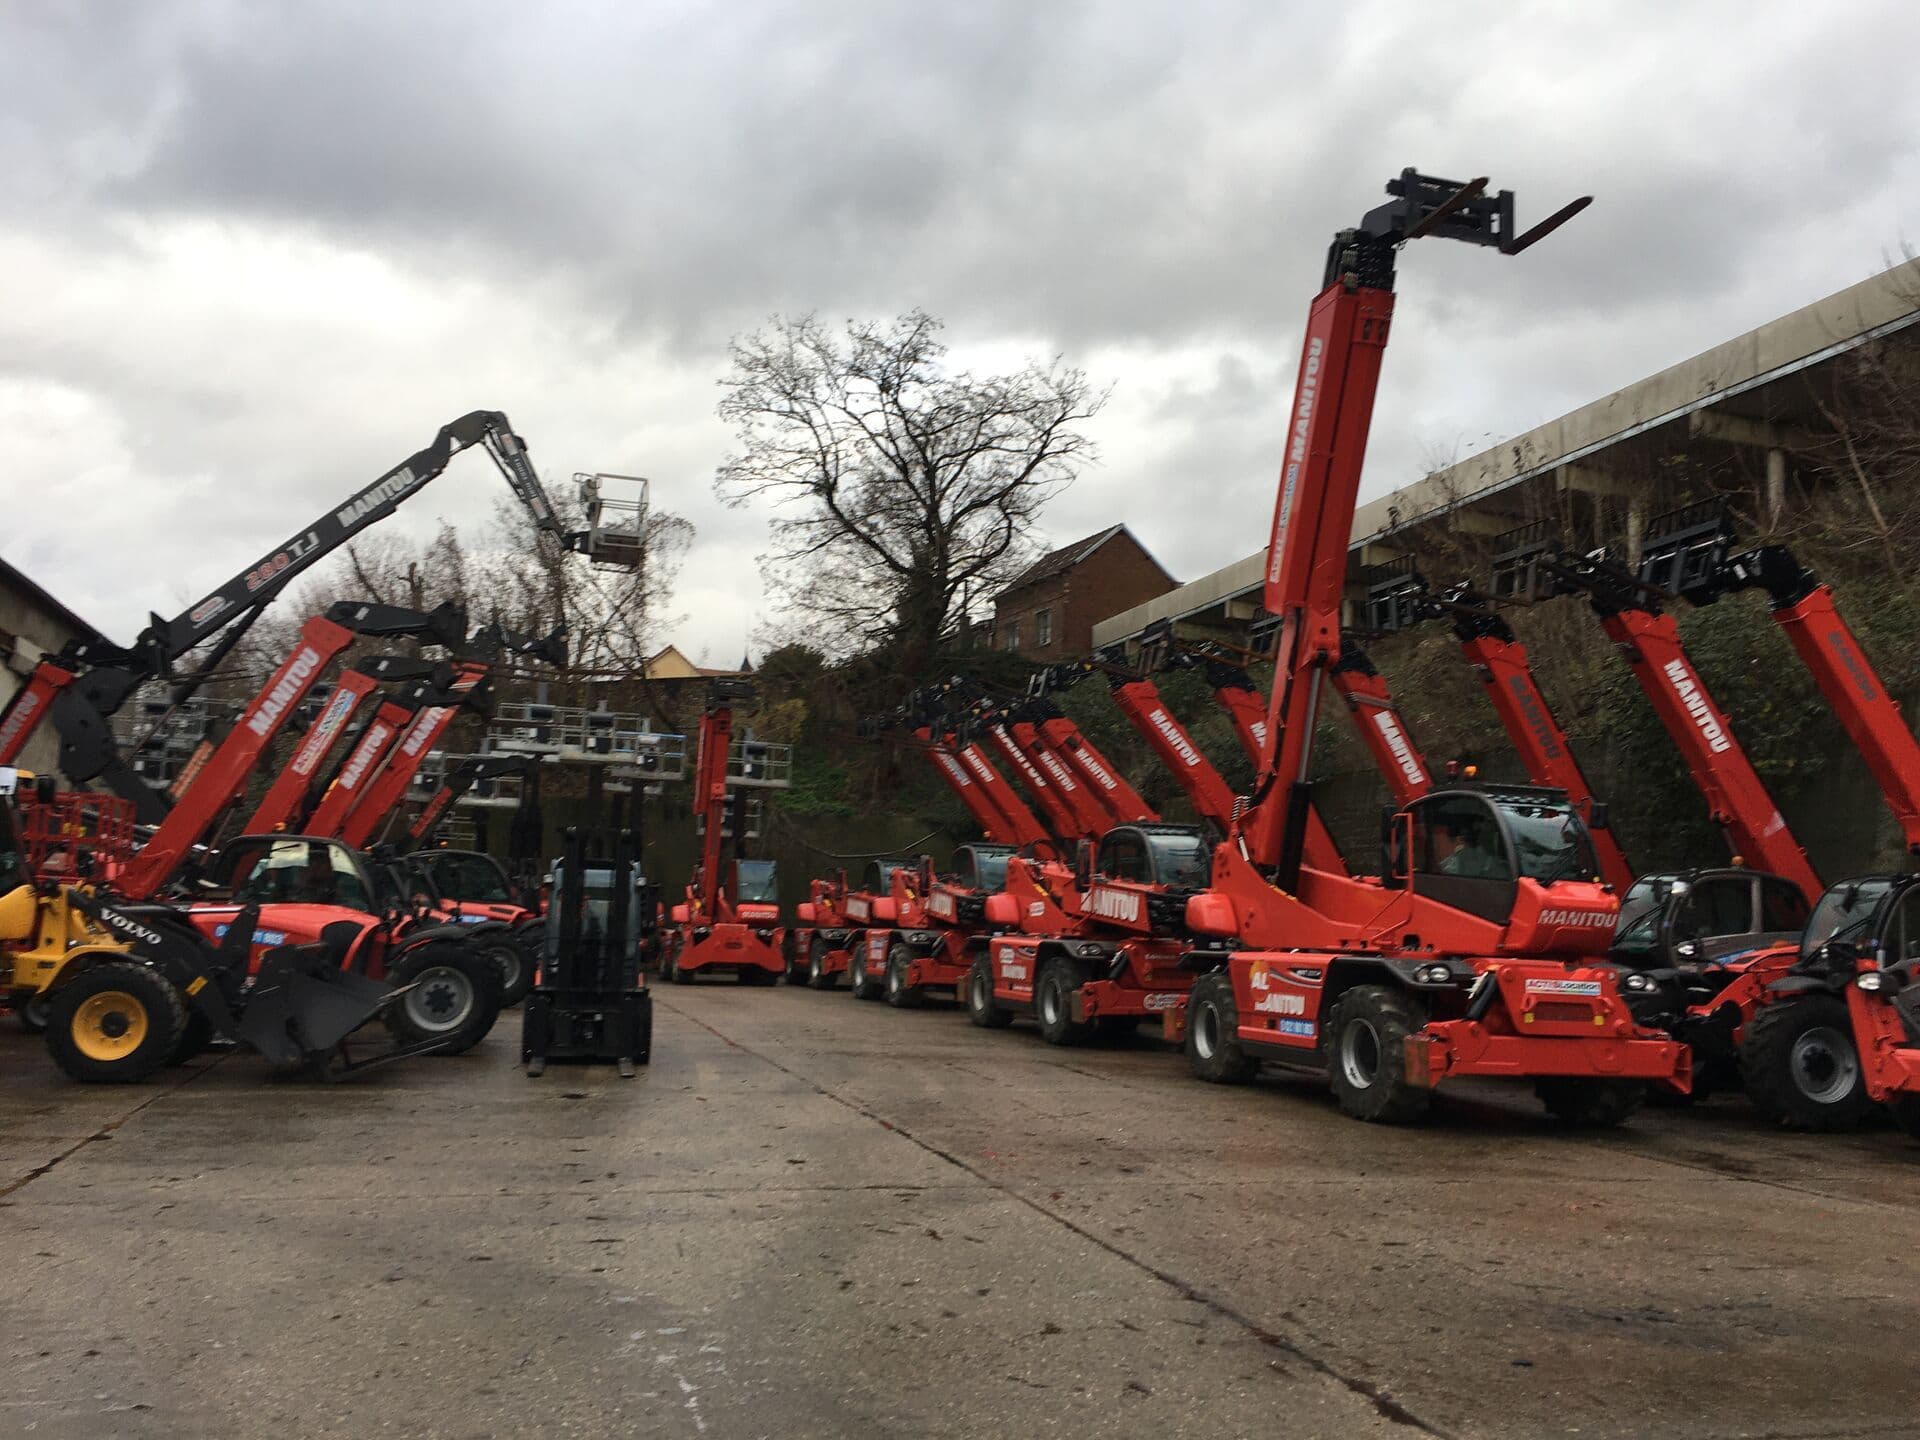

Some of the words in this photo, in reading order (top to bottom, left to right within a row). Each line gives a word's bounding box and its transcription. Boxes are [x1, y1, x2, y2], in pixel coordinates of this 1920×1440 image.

[1290, 337, 1323, 463] MANITOU
[336, 467, 415, 528] MANITOU
[0, 691, 39, 753] ANITOU
[247, 647, 319, 736] MANITOU
[1509, 675, 1561, 759] MANITOU
[1663, 658, 1732, 754] MANITOU
[339, 724, 388, 789] MANITOU
[963, 747, 995, 782] MANITOU
[1149, 709, 1201, 767] MANITOU
[1372, 710, 1425, 785] MANITOU
[1039, 751, 1077, 792] MANITOU
[1075, 748, 1118, 790] MANITOU
[100, 907, 162, 945] VOLVO
[1537, 909, 1618, 928] MANITOU
[1251, 971, 1270, 990] AL
